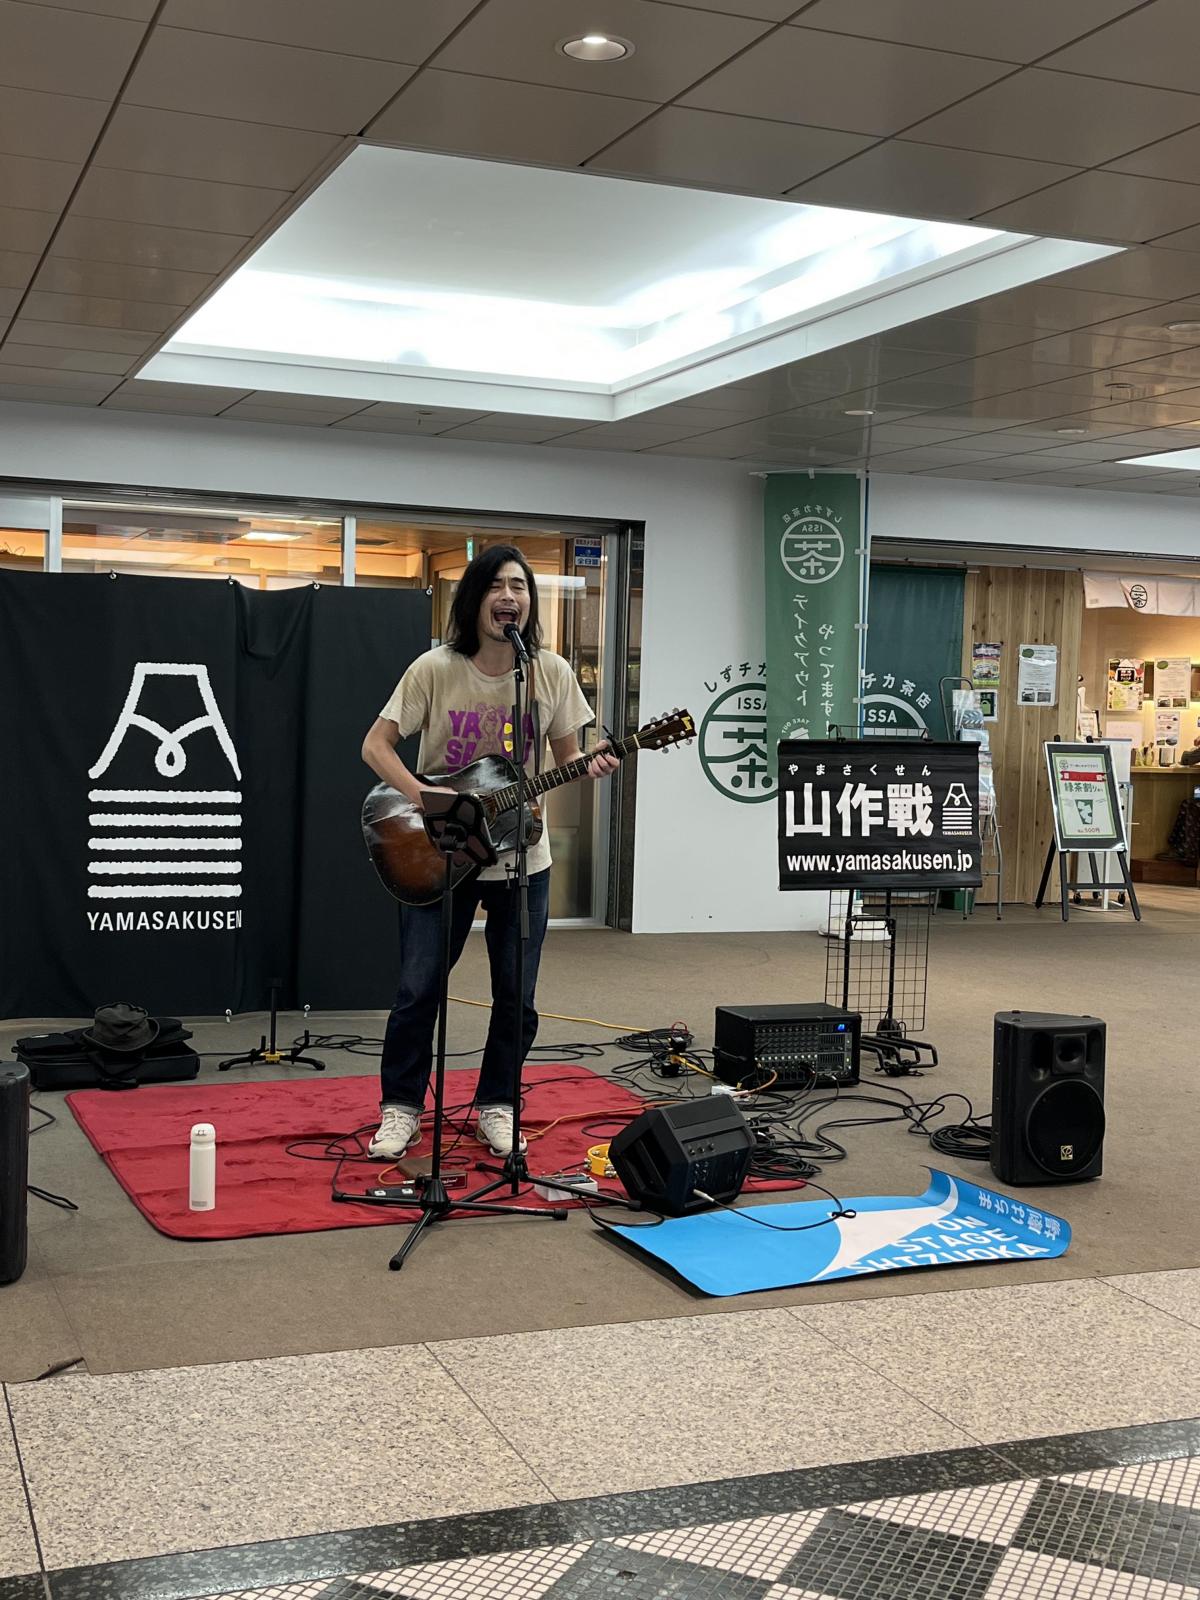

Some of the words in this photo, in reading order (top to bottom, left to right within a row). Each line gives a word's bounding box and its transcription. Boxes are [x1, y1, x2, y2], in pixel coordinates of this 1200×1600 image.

[788, 763, 932, 776] やまさくせん
[786, 850, 973, 873] www.yamasakusen.jp
[86, 910, 242, 932] YAMASAKUSEN
[934, 1215, 988, 1231] ON
[891, 1228, 1019, 1252] STAGE
